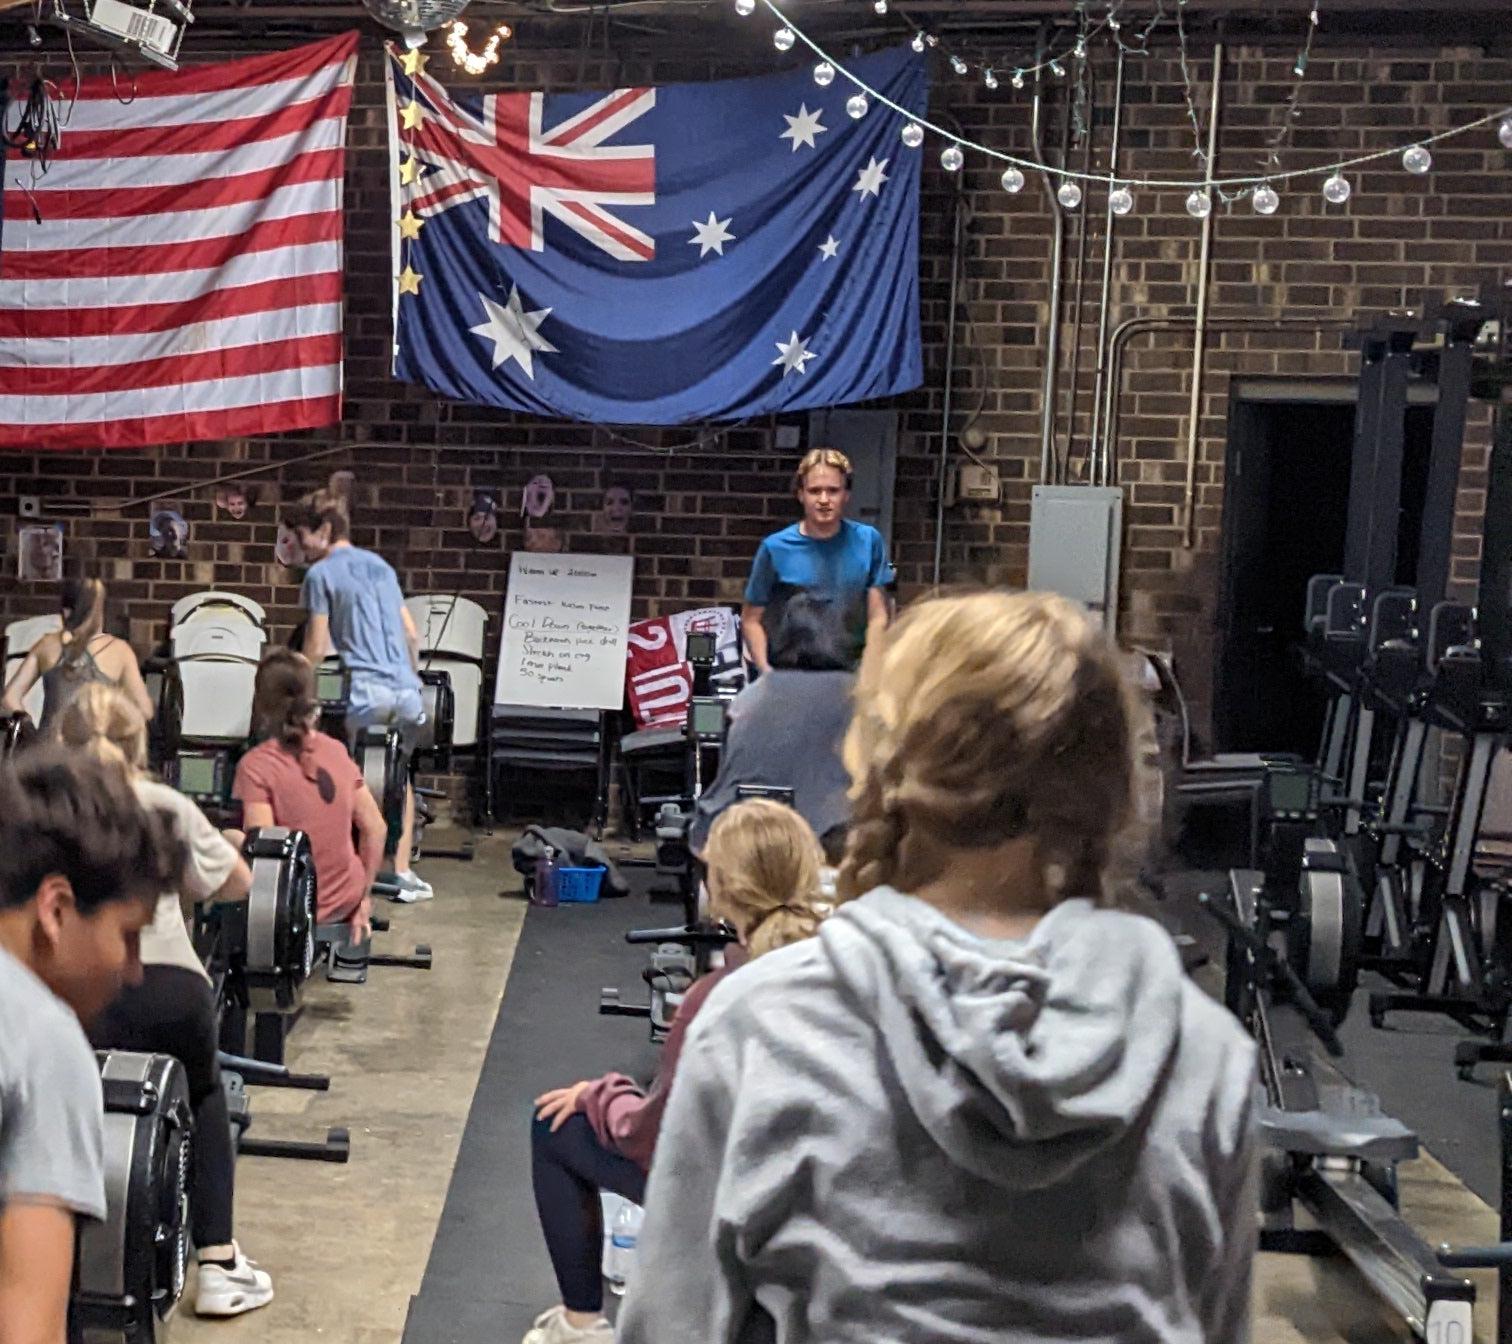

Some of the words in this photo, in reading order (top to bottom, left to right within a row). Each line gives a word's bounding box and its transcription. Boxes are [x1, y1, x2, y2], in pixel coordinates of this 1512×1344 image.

[508, 613, 536, 630] Cool
[541, 616, 570, 631] Down
[519, 667, 535, 677] 50
